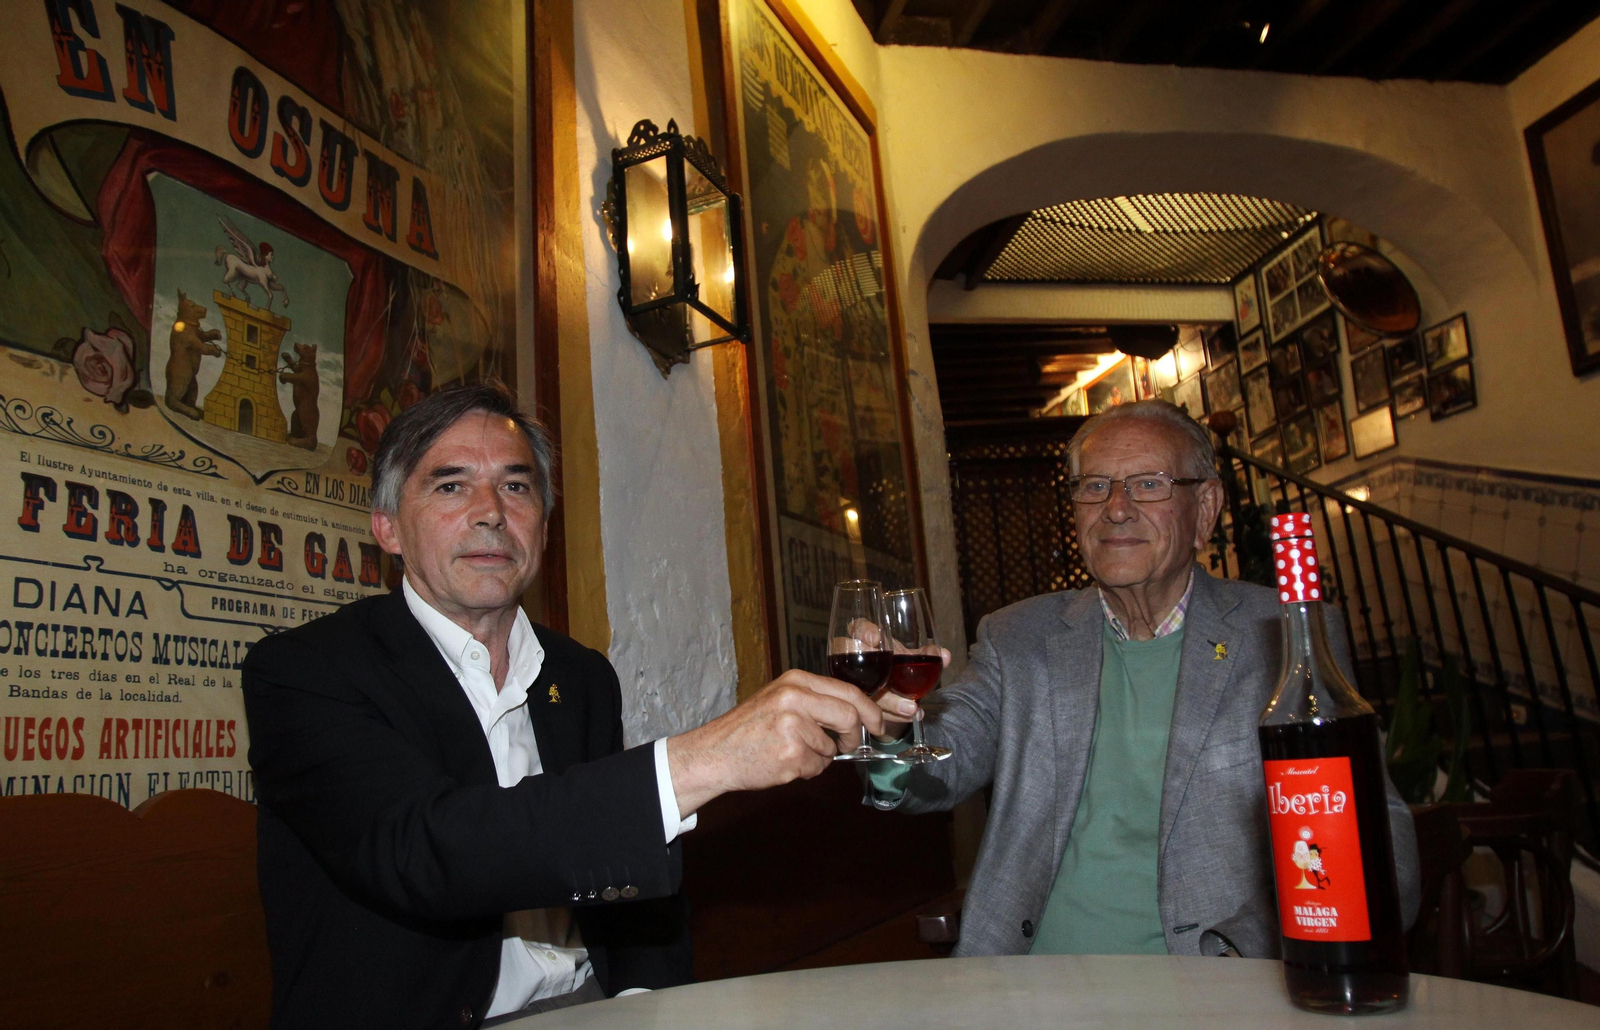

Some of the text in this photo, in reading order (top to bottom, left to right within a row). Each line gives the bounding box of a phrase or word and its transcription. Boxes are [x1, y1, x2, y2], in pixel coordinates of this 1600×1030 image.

[45, 0, 439, 260] EN OSUNA
[20, 451, 31, 463] El
[37, 454, 74, 472] Ilustre
[80, 464, 153, 489] Ayuntamiento
[157, 481, 168, 492] de
[172, 484, 192, 497] esta
[221, 496, 231, 506] en
[235, 498, 242, 508] el
[246, 501, 267, 514] deseo
[270, 506, 279, 517] de
[282, 510, 319, 525] estimular
[321, 517, 328, 527] la
[305, 471, 319, 495] EN
[324, 476, 345, 501] LOS
[18, 471, 202, 559] FERIA
[226, 513, 283, 573] DE
[163, 561, 188, 575] ha
[198, 568, 295, 591] organizado
[301, 584, 315, 595] el
[13, 576, 148, 620] DIANA
[211, 596, 276, 618] PROGRAMA
[282, 606, 295, 620] DE
[19, 665, 41, 679] los
[51, 668, 80, 681] tres
[88, 669, 117, 683] días
[125, 674, 141, 684] en
[149, 673, 160, 684] el
[167, 674, 195, 687] Real
[203, 676, 216, 687] de
[223, 677, 233, 688] la
[8, 684, 182, 704] Bandas de la localidad.
[0, 716, 236, 762] UEGOS ARTIFICIALES
[1281, 766, 1319, 776] Moscatel
[1268, 782, 1346, 815] Iberia
[1293, 905, 1339, 916] MALAGA
[1295, 916, 1338, 927] VIRGEN
